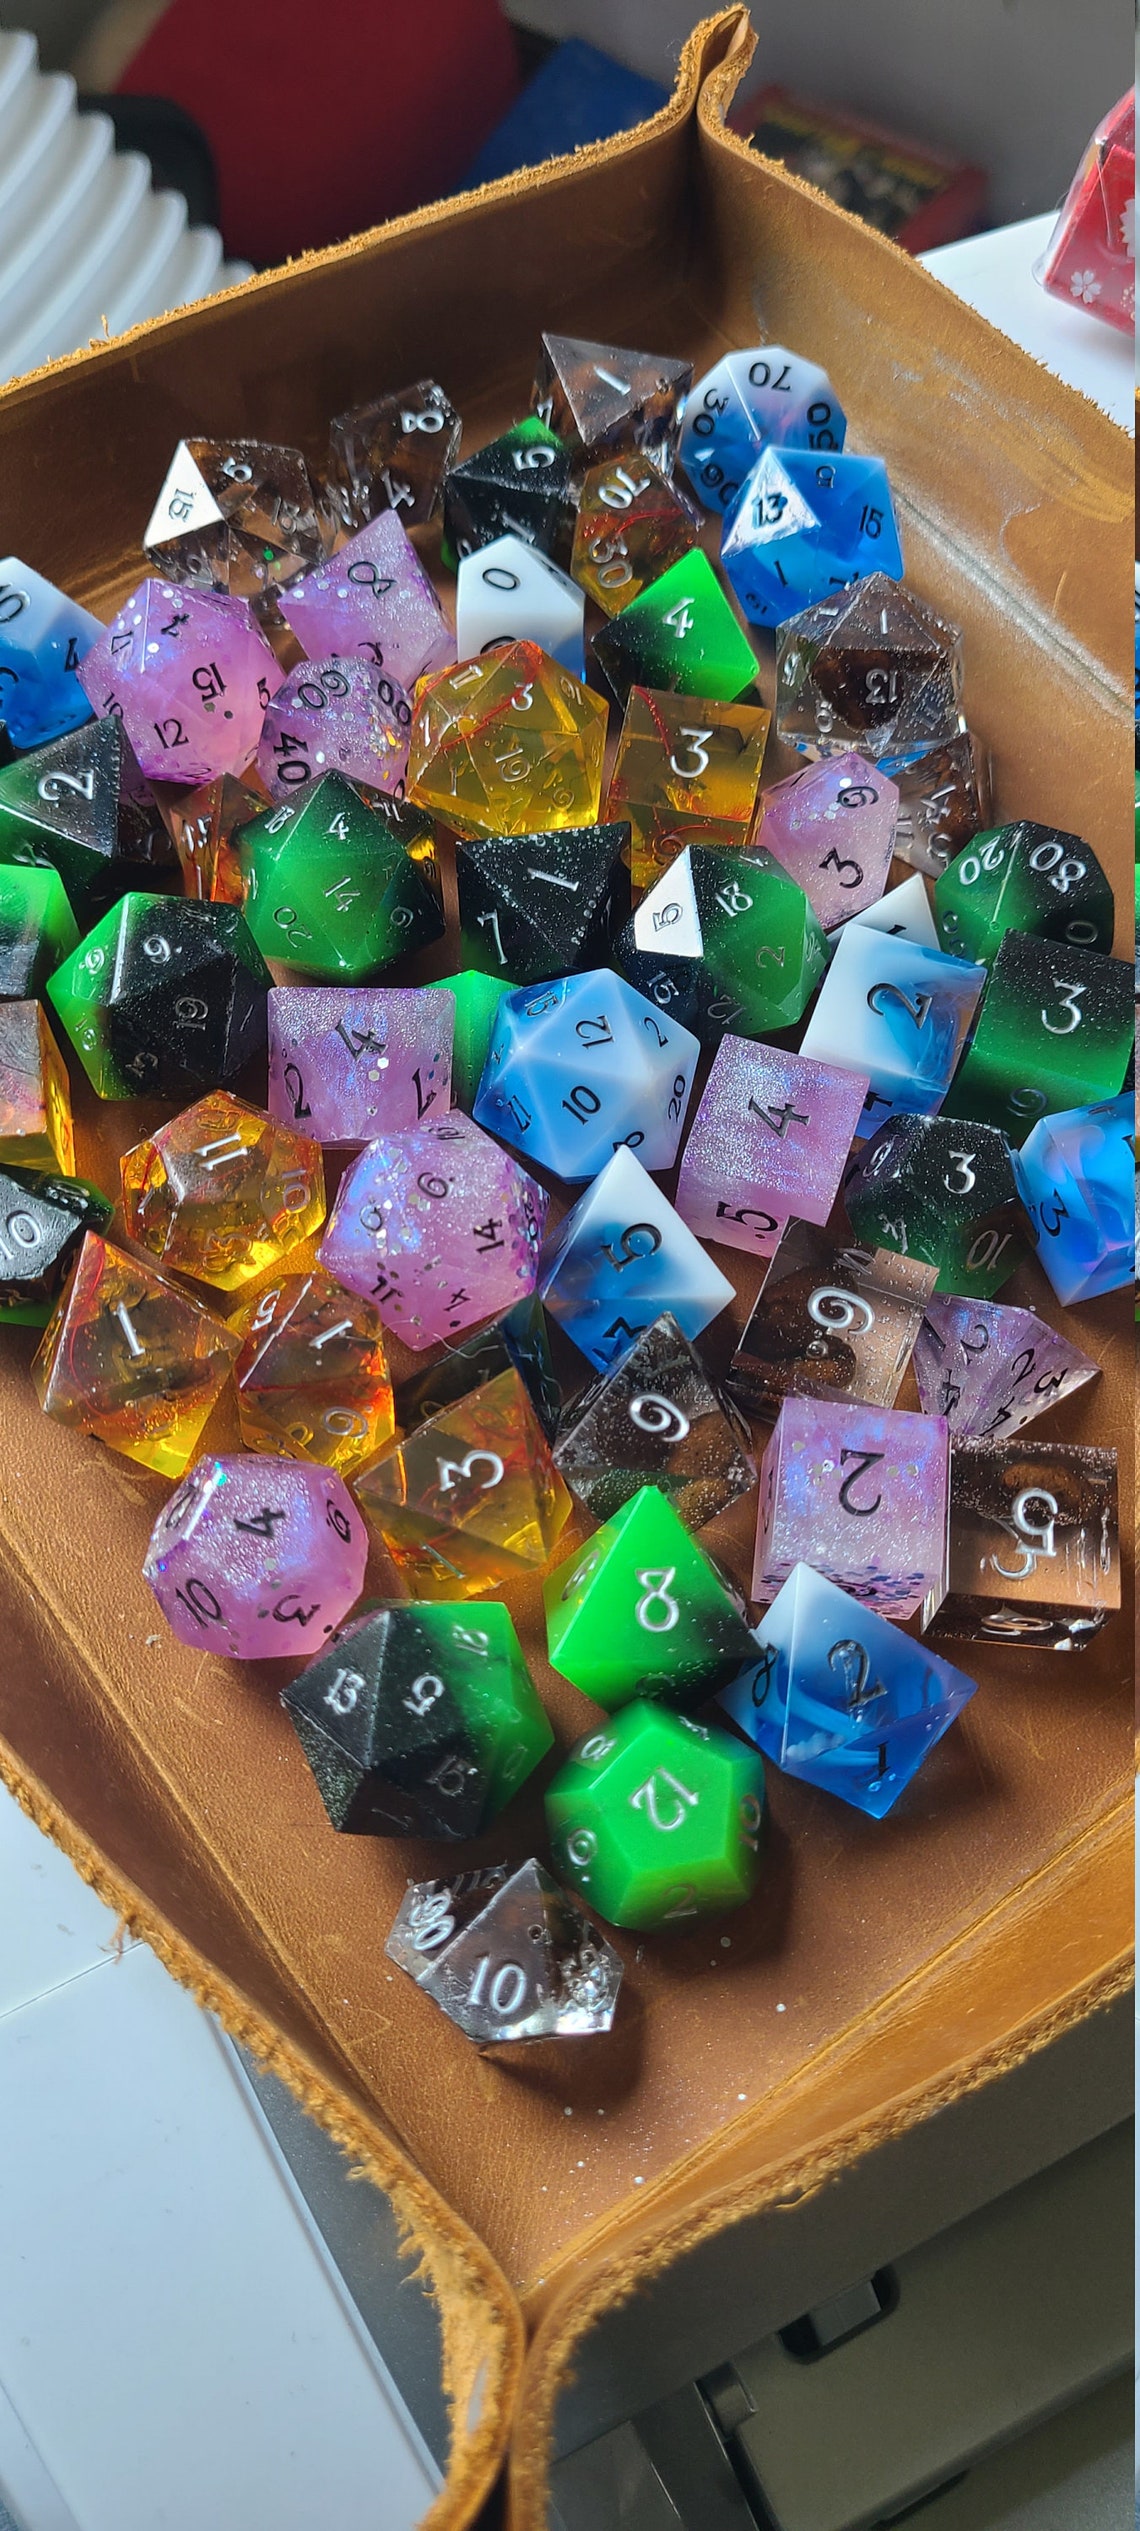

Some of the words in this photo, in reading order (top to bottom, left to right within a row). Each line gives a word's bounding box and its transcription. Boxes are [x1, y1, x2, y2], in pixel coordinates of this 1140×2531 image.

[748, 362, 792, 392] 70
[692, 388, 728, 437] 30
[513, 446, 555, 471] 5
[599, 467, 650, 509] 70
[753, 492, 788, 528] 13
[859, 504, 884, 539] 15
[348, 561, 397, 600] 8
[482, 567, 520, 592] 0
[773, 561, 788, 587] 1
[662, 597, 695, 639] 4
[191, 662, 229, 702] 15
[256, 678, 271, 711] 5
[511, 681, 534, 712] 3
[153, 718, 190, 749] 12
[670, 726, 714, 779] 3
[273, 732, 313, 786] 40
[38, 768, 95, 802] 2
[322, 812, 349, 840] 4
[527, 866, 580, 893] 1
[818, 847, 864, 889] 3
[958, 836, 1004, 886] 20
[1028, 842, 1087, 894] 80
[322, 876, 360, 912] 14
[715, 881, 754, 918] 18
[273, 906, 312, 949] 20
[476, 908, 508, 965] 7
[652, 902, 684, 933] 5
[755, 945, 786, 969] 2
[647, 971, 681, 1004] 15
[867, 982, 933, 1030] 2
[1040, 979, 1087, 1035] 3
[335, 1018, 387, 1062] 4
[575, 1014, 615, 1050] 12
[643, 1016, 670, 1048] 2
[284, 1062, 312, 1119] 2
[561, 1084, 602, 1126] 10
[668, 1073, 687, 1124] 20
[748, 1096, 811, 1140] 4
[194, 1132, 249, 1171] 11
[943, 1149, 977, 1194] 3
[715, 1200, 779, 1232] 5
[1039, 1189, 1070, 1237] 3
[473, 1217, 505, 1255] 14
[600, 1221, 662, 1274] 5
[251, 1289, 282, 1332] 5
[443, 1287, 471, 1313] 4
[112, 1301, 146, 1357] 1
[308, 1318, 353, 1349] 1
[435, 1450, 505, 1492] 3
[838, 1448, 886, 1517] 2
[234, 1507, 286, 1539] 4
[175, 1578, 222, 1629] 10
[272, 1594, 322, 1627] 3
[634, 1566, 681, 1633] 8
[826, 1638, 889, 1709] 2
[402, 1675, 445, 1716] 5
[876, 1741, 895, 1778] 1
[628, 1765, 699, 1832] 12
[467, 1954, 527, 2015] 10
